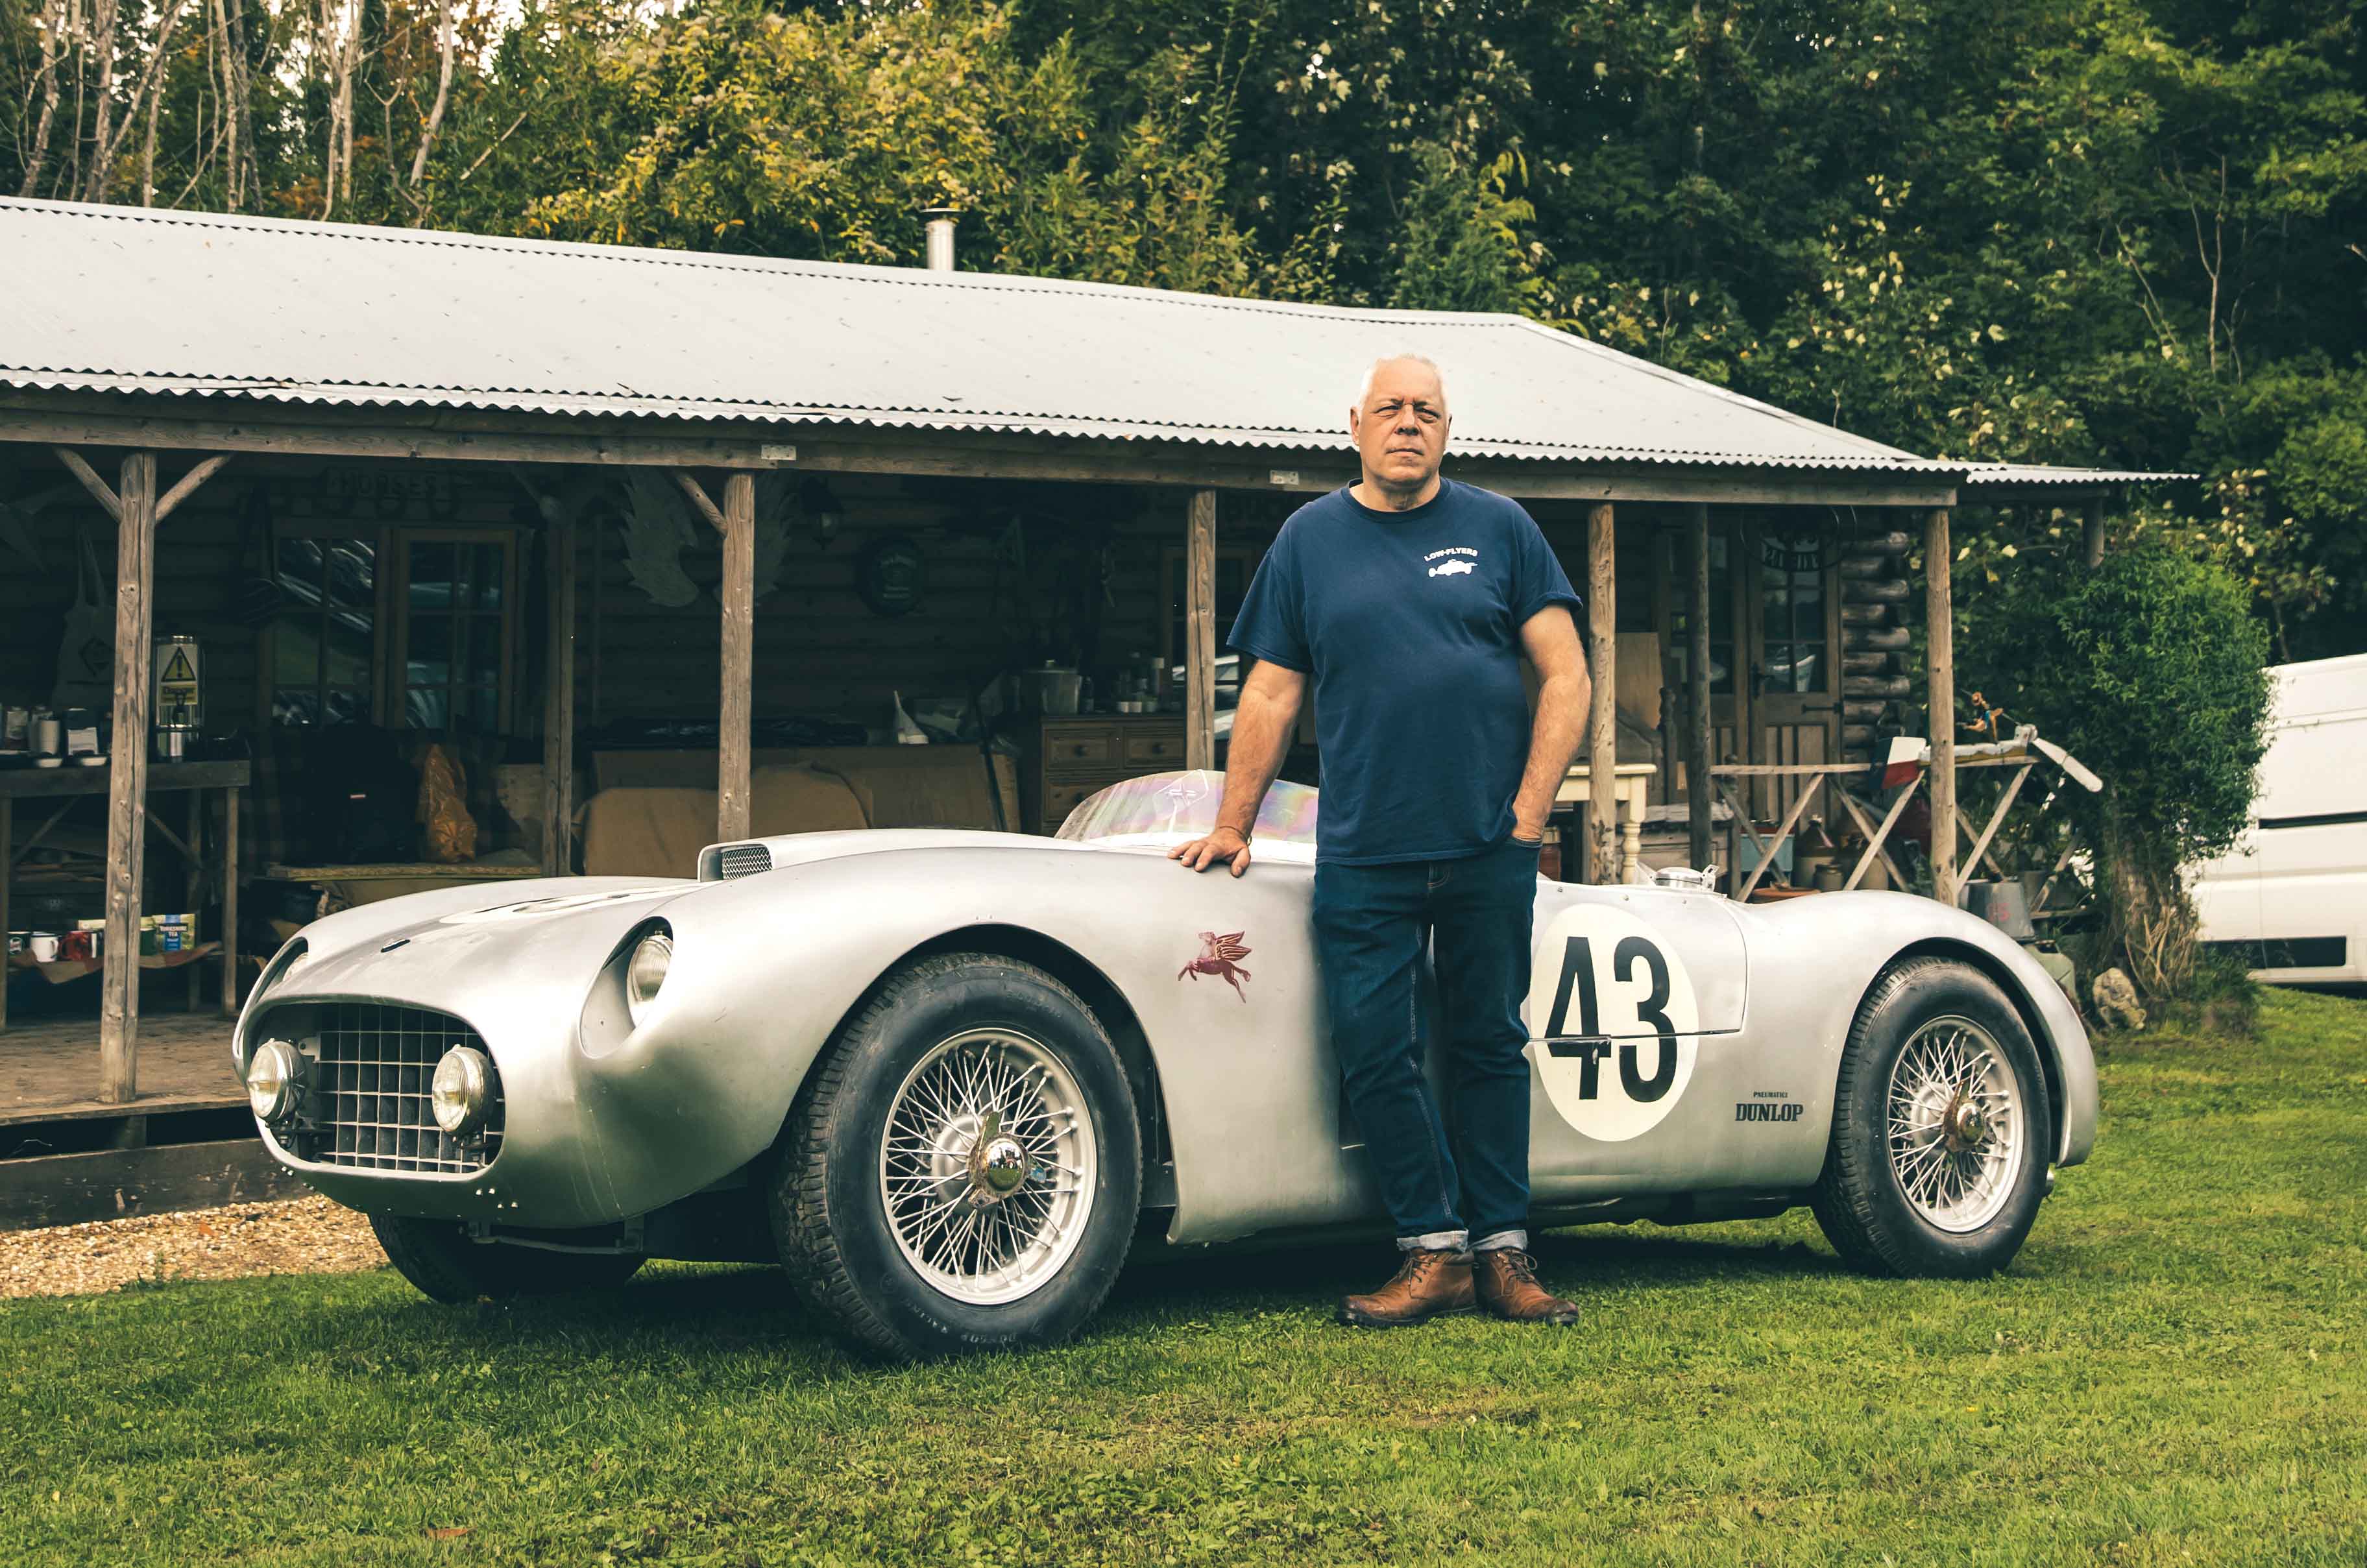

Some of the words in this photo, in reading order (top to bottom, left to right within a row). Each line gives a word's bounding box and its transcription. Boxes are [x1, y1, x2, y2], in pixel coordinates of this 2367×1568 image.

[1424, 547, 1478, 562] LOW-FLYERS
[1544, 936, 1677, 1103] 43
[1735, 1104, 1804, 1122] DUNLOP
